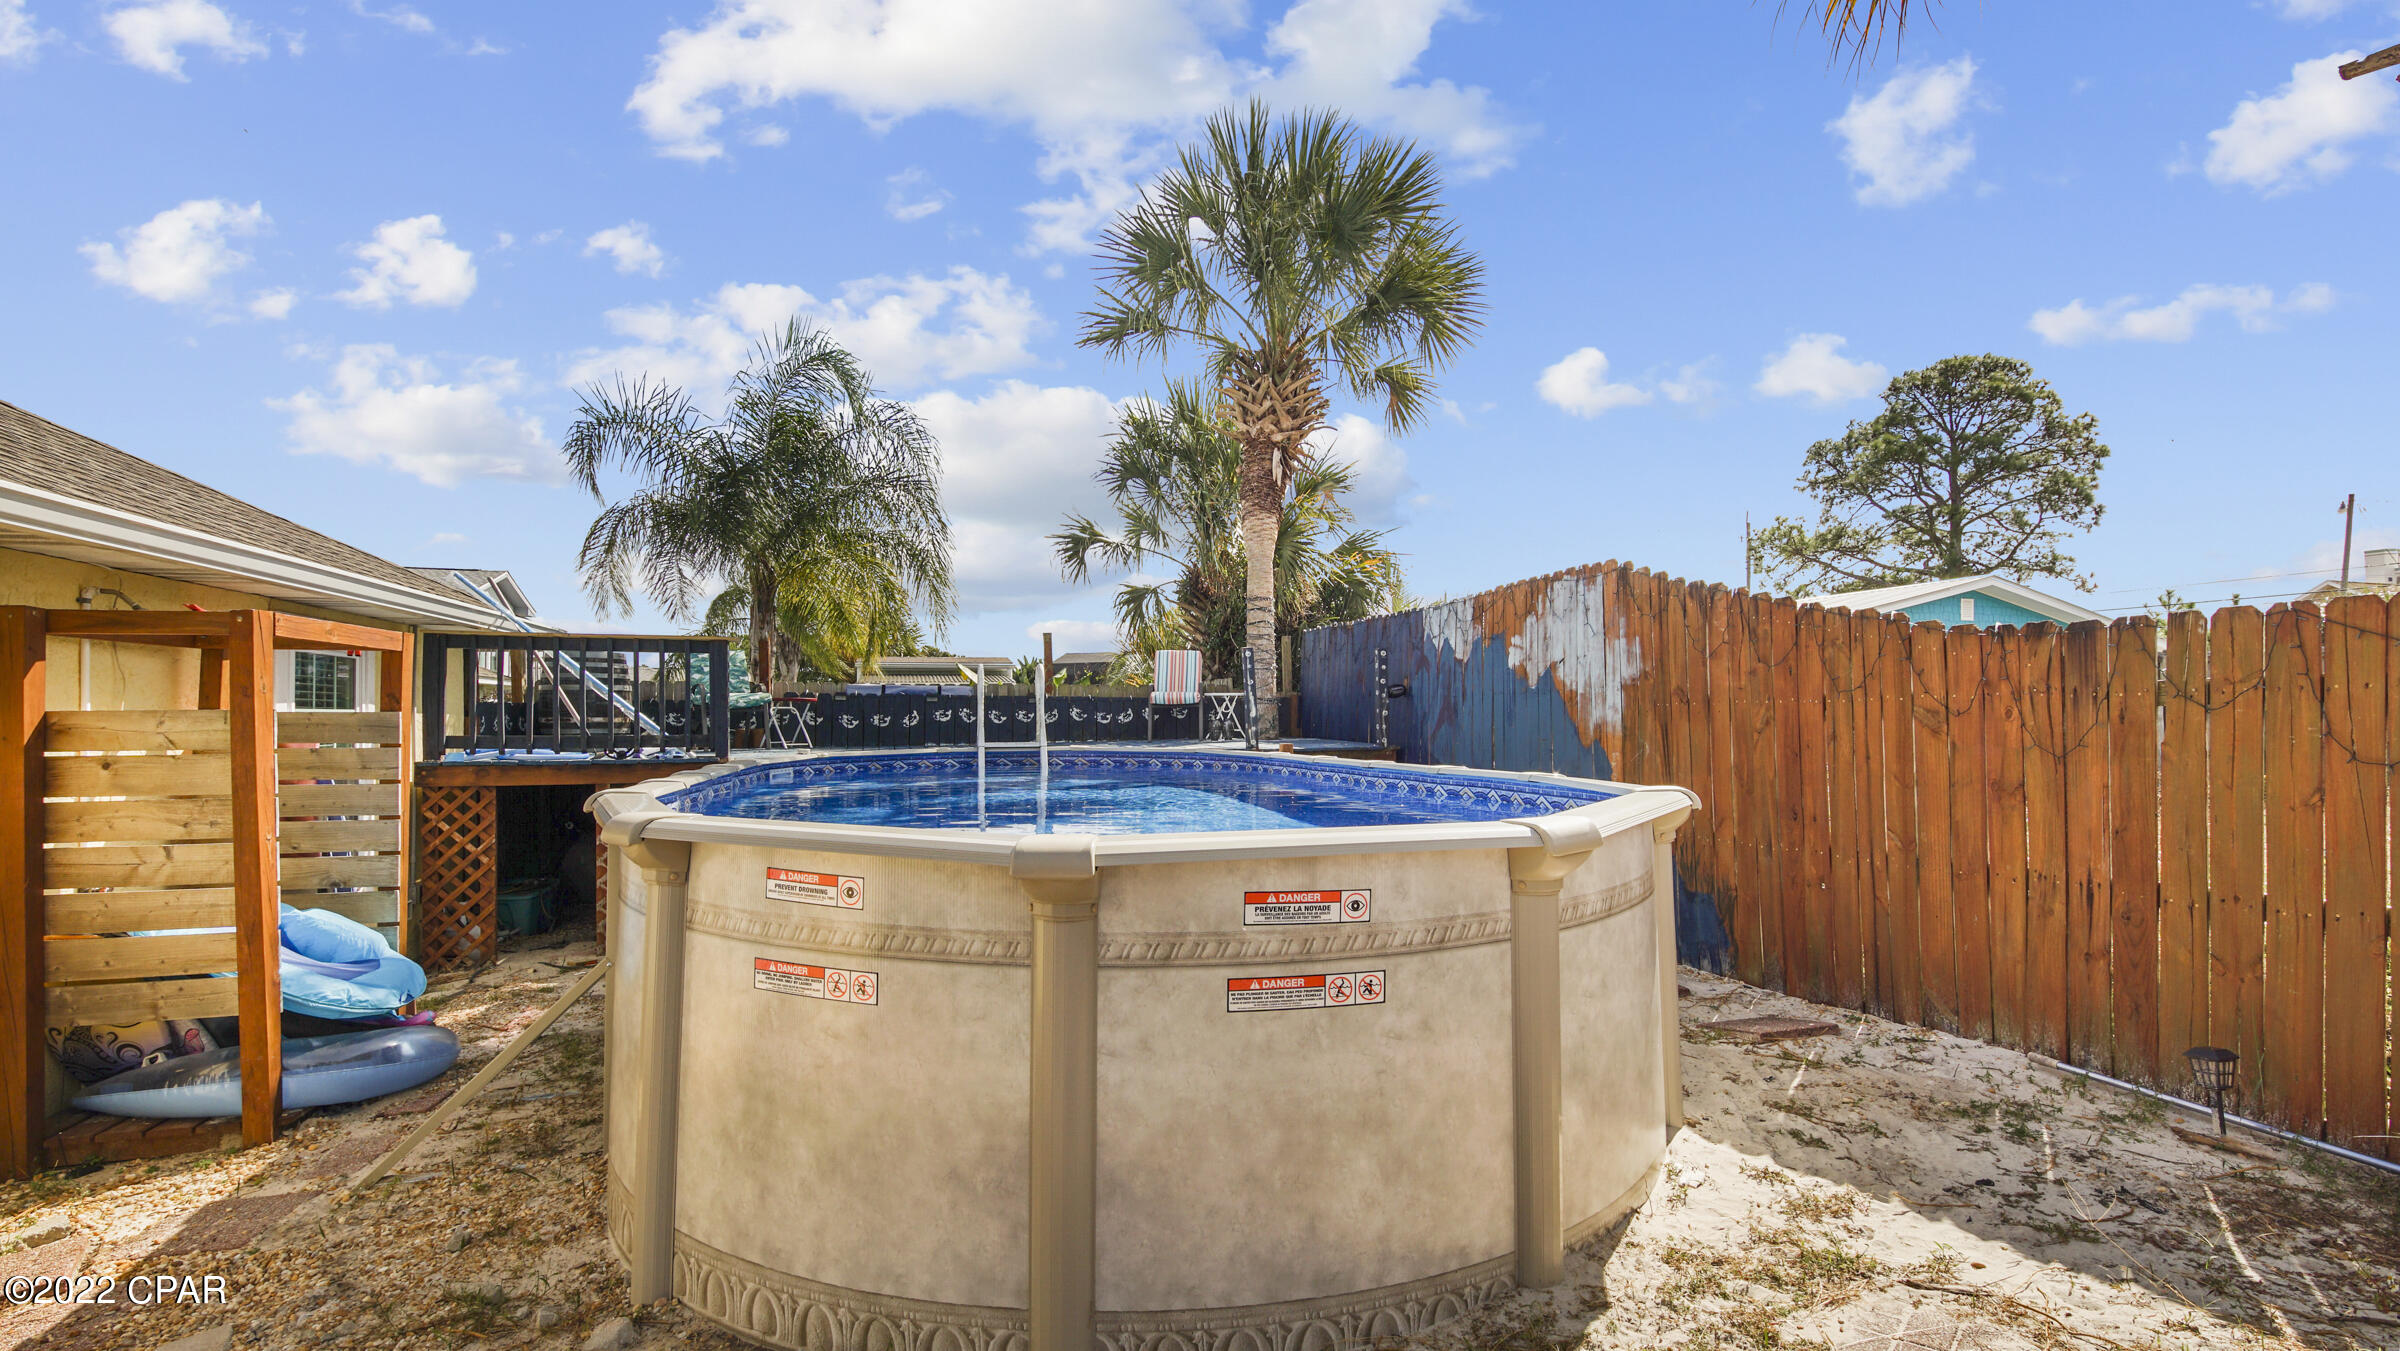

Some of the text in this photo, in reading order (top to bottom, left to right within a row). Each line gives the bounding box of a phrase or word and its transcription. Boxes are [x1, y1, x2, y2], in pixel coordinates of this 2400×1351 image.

[788, 872, 819, 884] DANGER
[774, 883, 797, 891] PREVENT
[798, 885, 828, 895] DROWNING
[1279, 893, 1321, 903] DANGER
[1254, 904, 1291, 912] PRÉVENEZ
[778, 963, 808, 976] DANGER
[1262, 979, 1304, 988] DANGER
